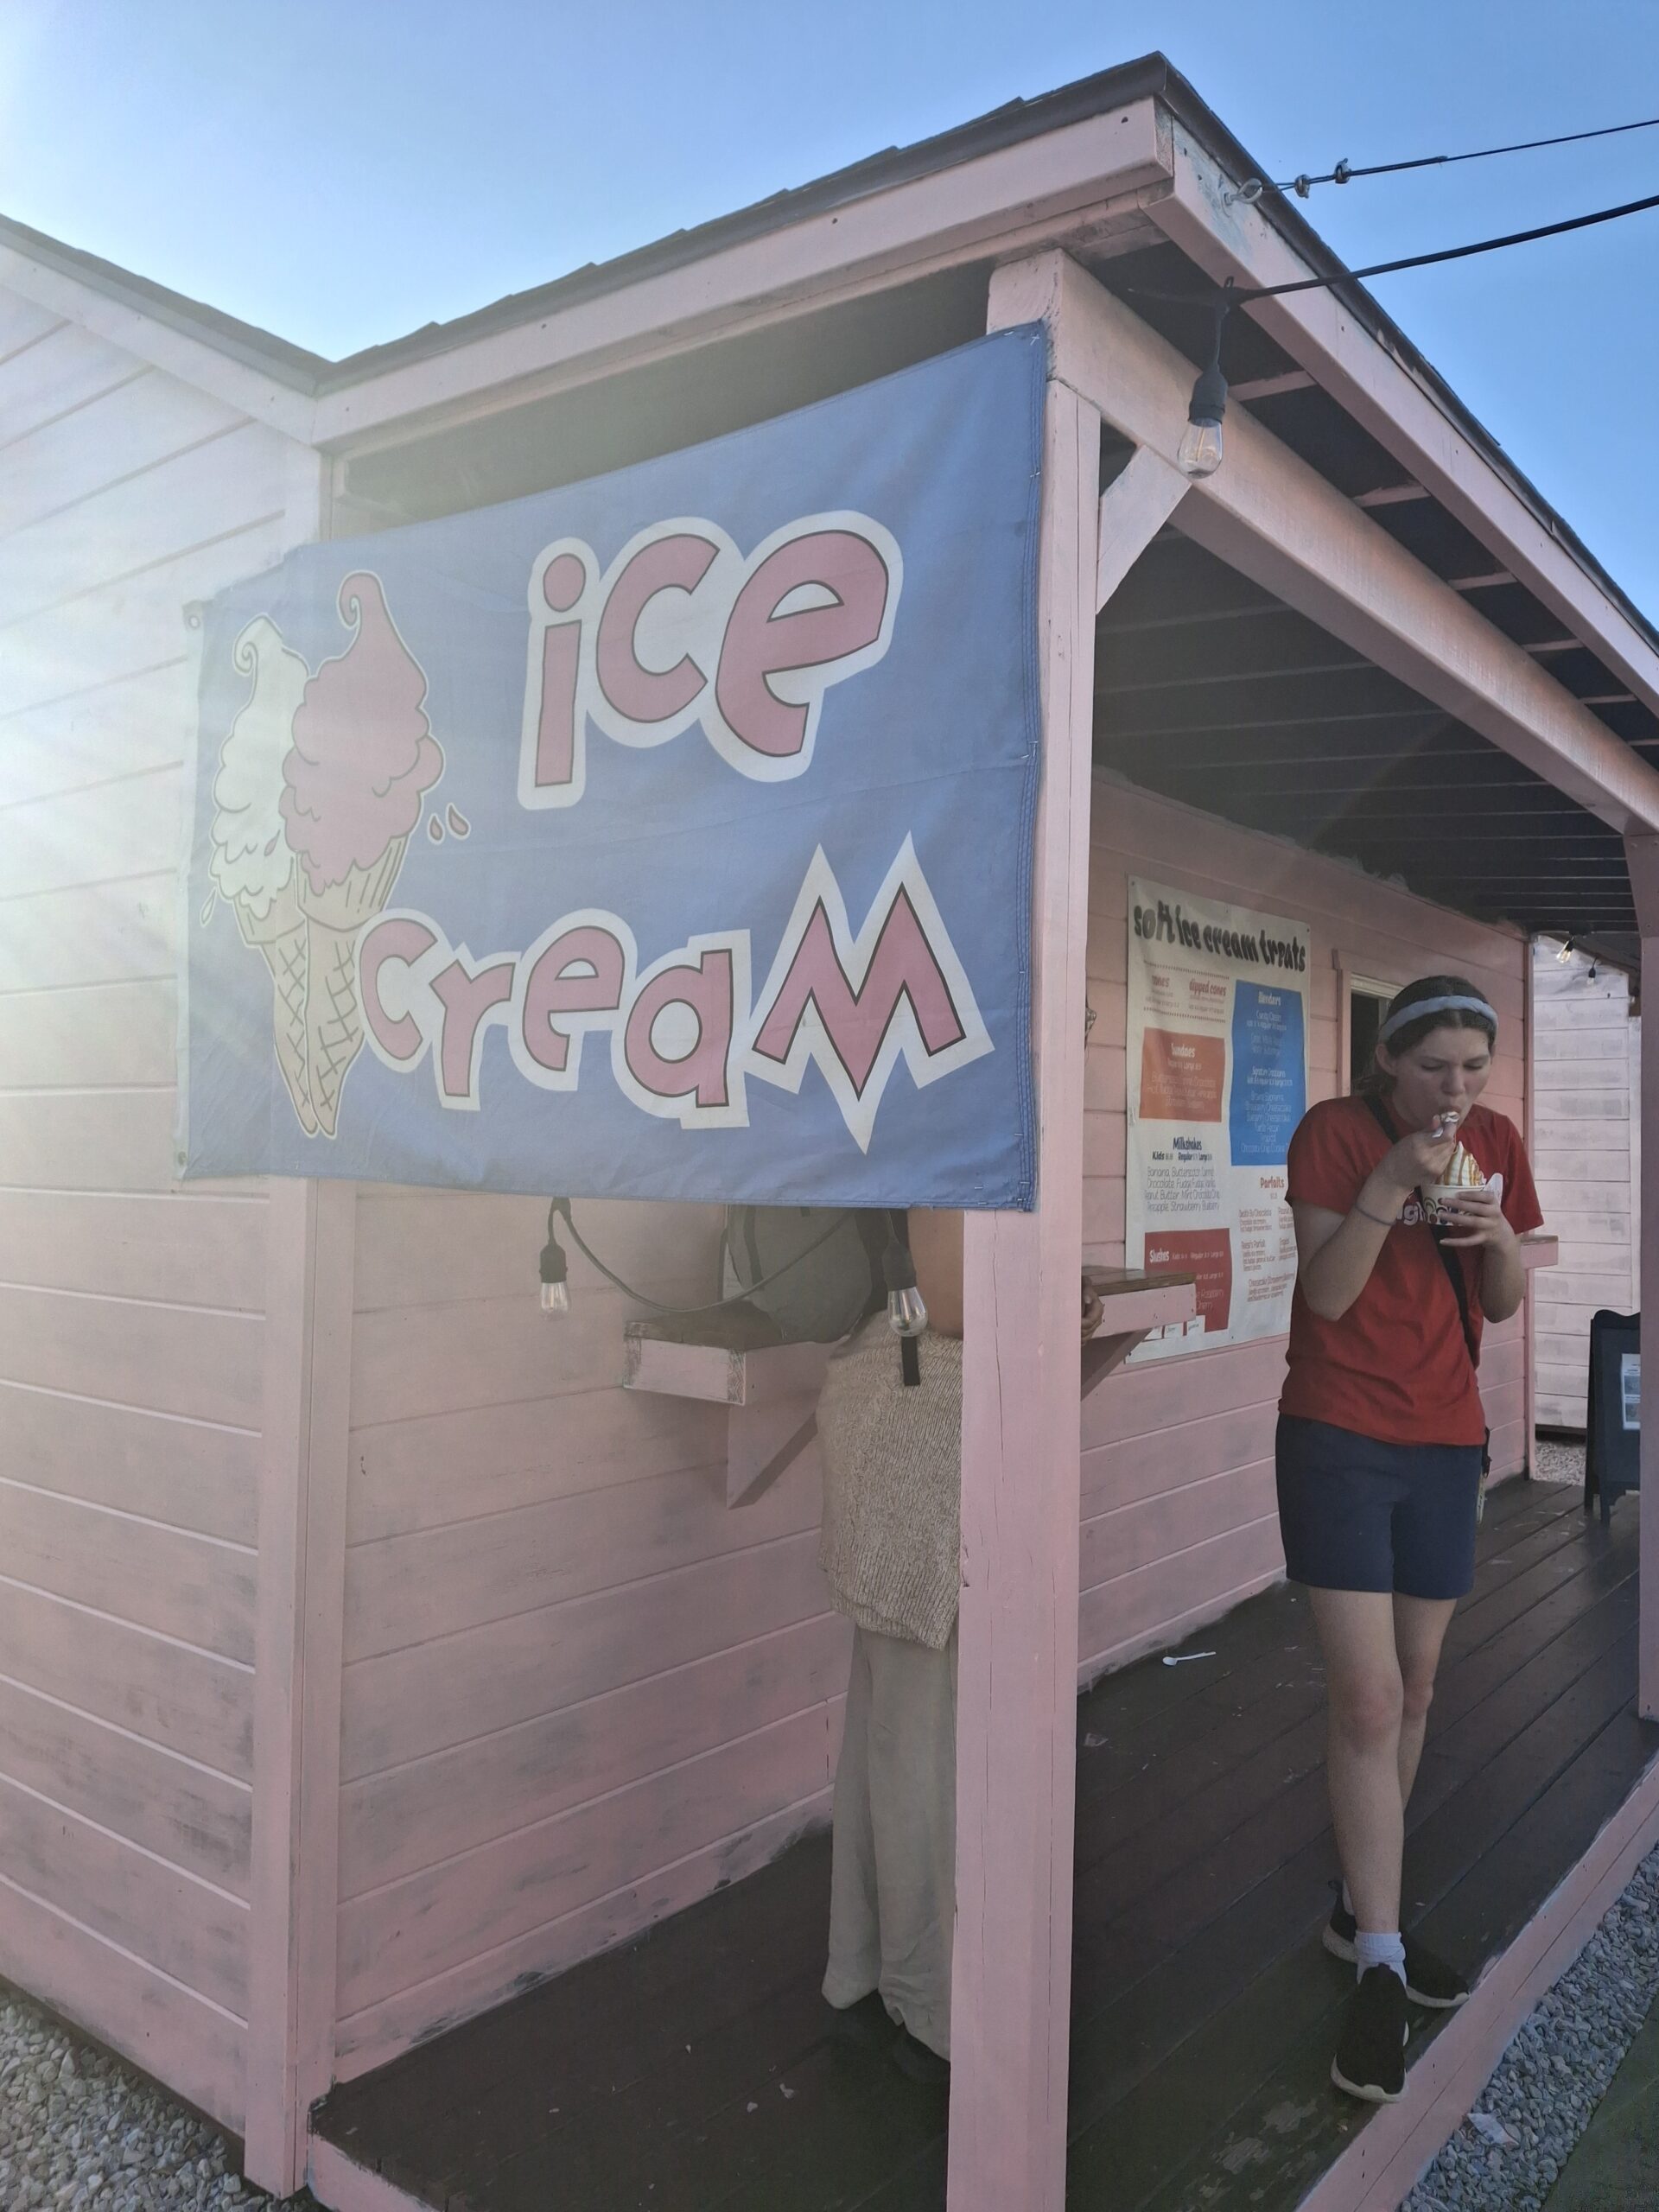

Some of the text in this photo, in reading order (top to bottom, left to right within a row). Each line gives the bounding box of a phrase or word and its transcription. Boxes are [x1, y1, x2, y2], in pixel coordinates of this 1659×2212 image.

[522, 515, 899, 805] ice
[1134, 899, 1306, 972] soft ice cream treats
[1189, 978, 1210, 995] dipped
[1173, 1136, 1202, 1151] Milkshakes
[1260, 1176, 1284, 1189] Parfaits
[1149, 1248, 1170, 1262] Slushes
